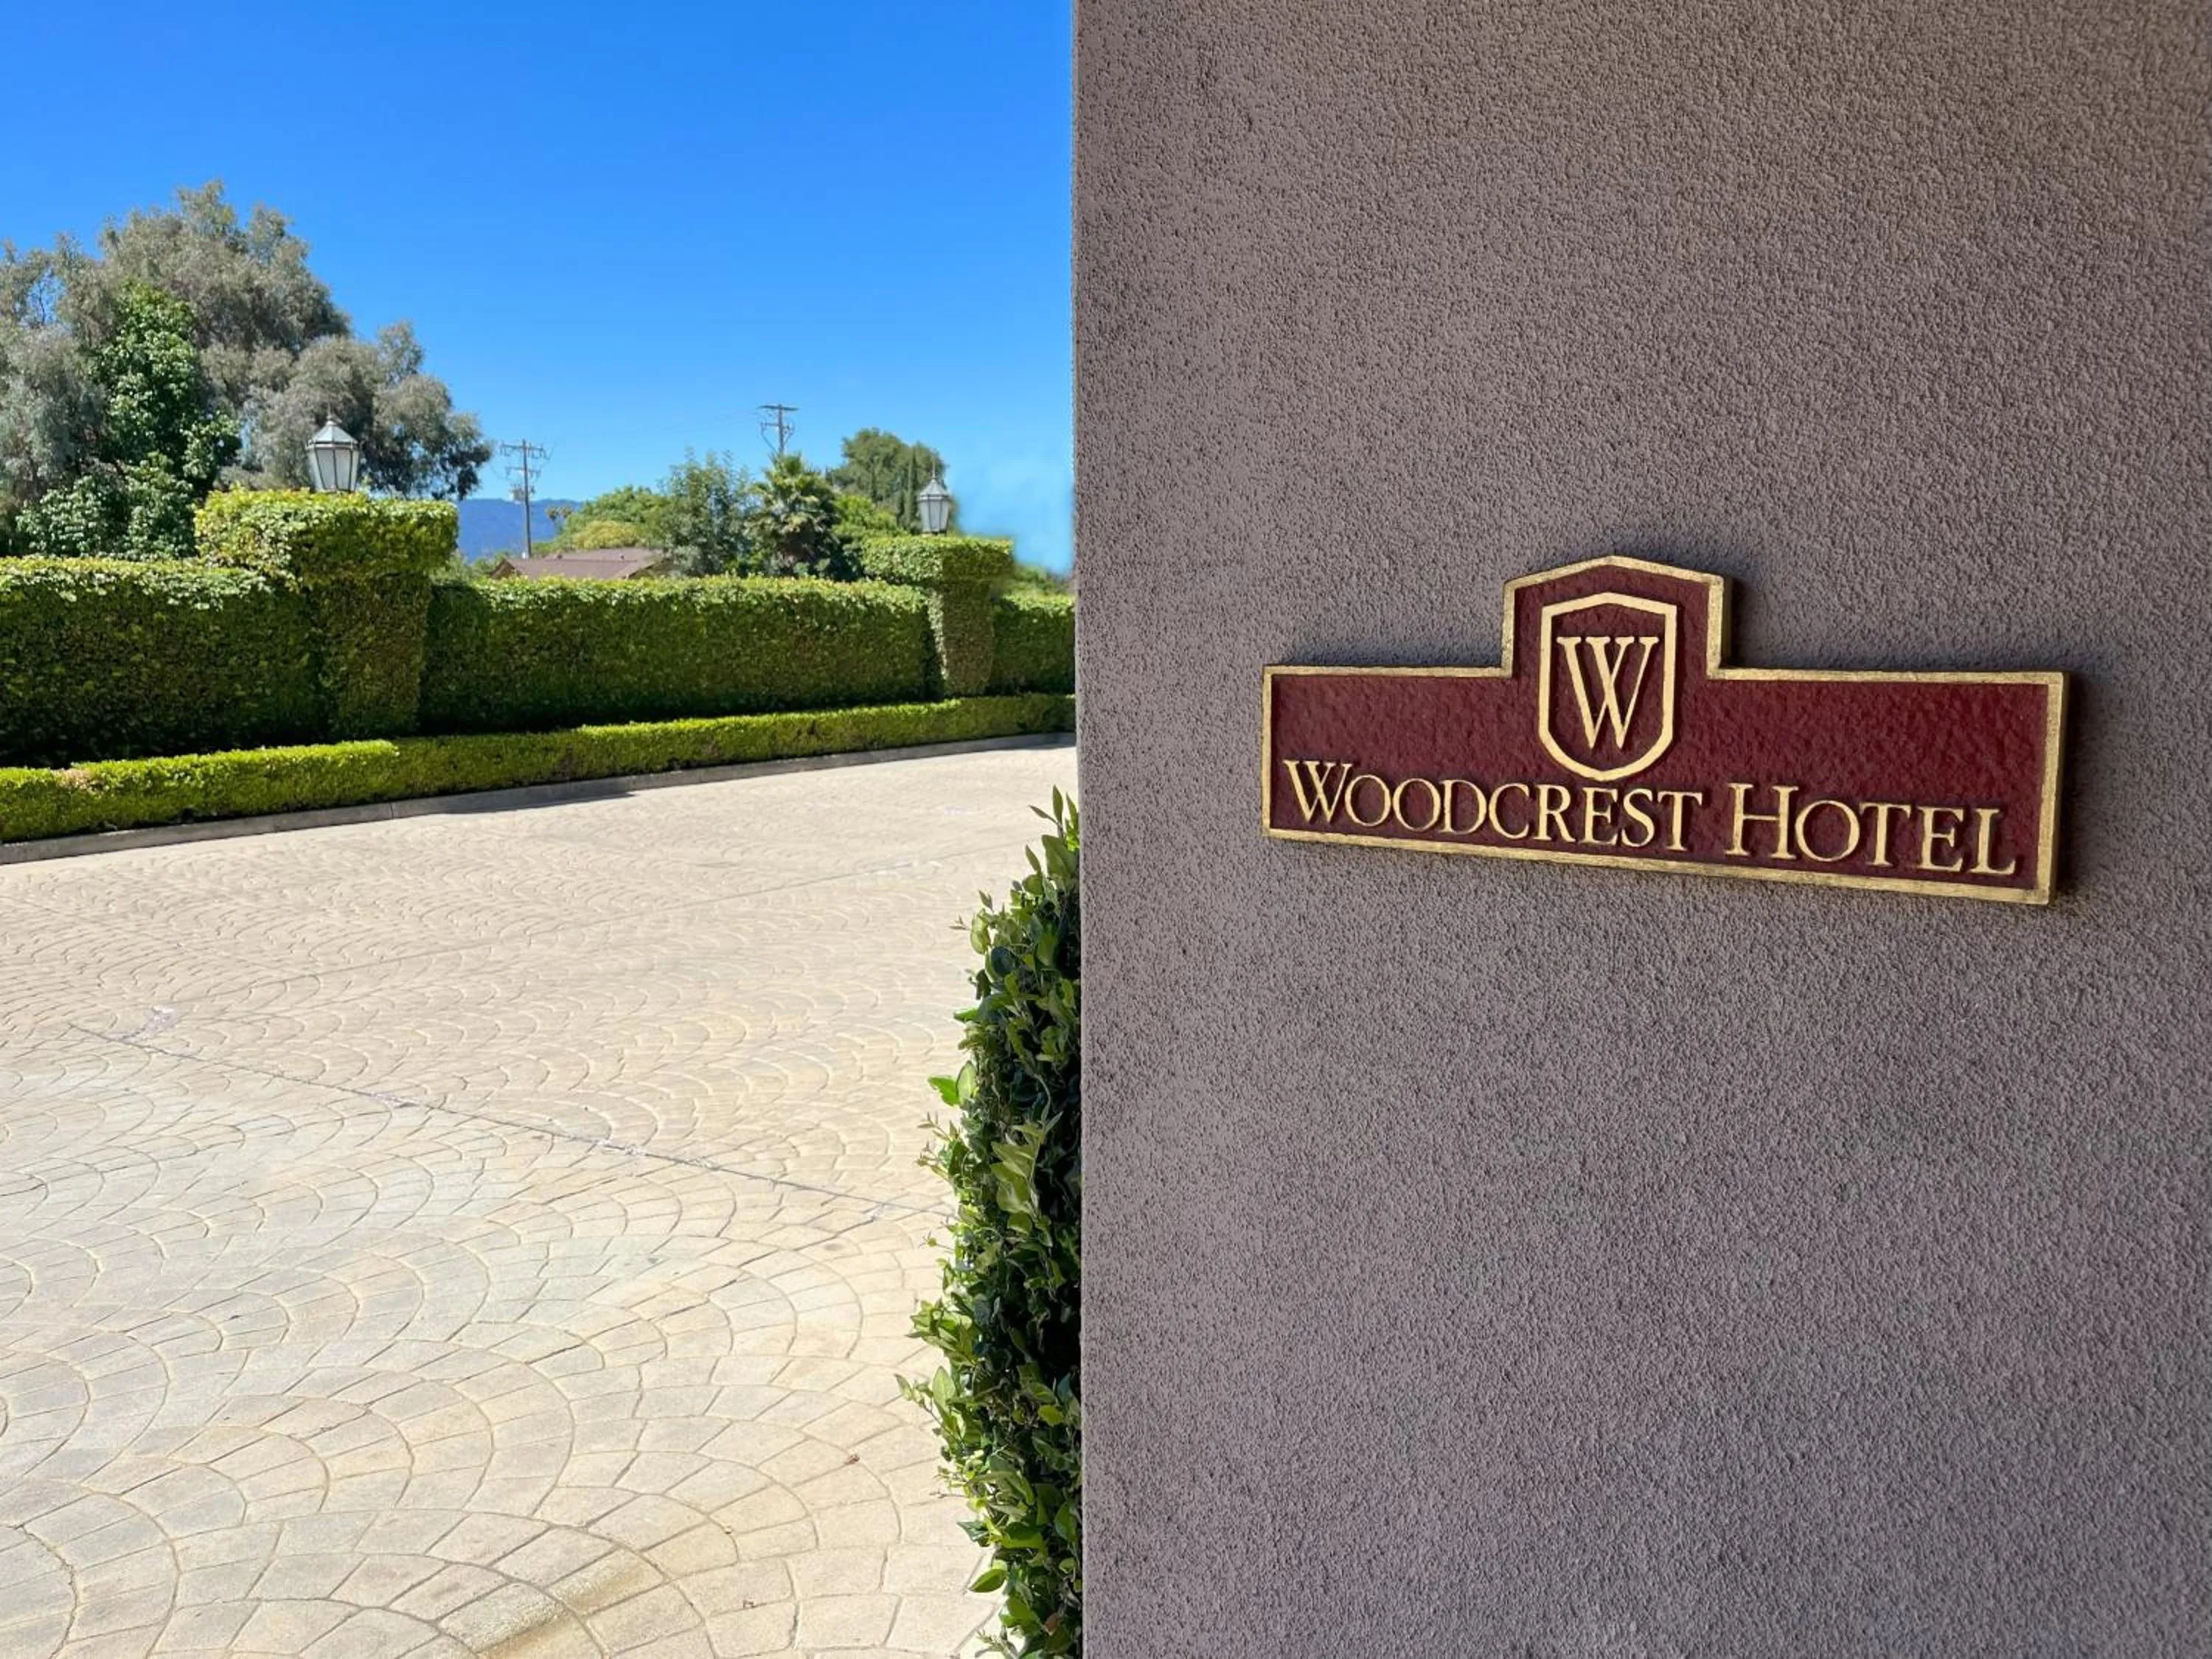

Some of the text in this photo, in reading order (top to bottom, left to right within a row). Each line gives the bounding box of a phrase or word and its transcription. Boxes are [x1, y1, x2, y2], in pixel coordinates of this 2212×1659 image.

[1556, 636, 1659, 750] W
[1282, 759, 2017, 876] WOODCREST HOTEL
